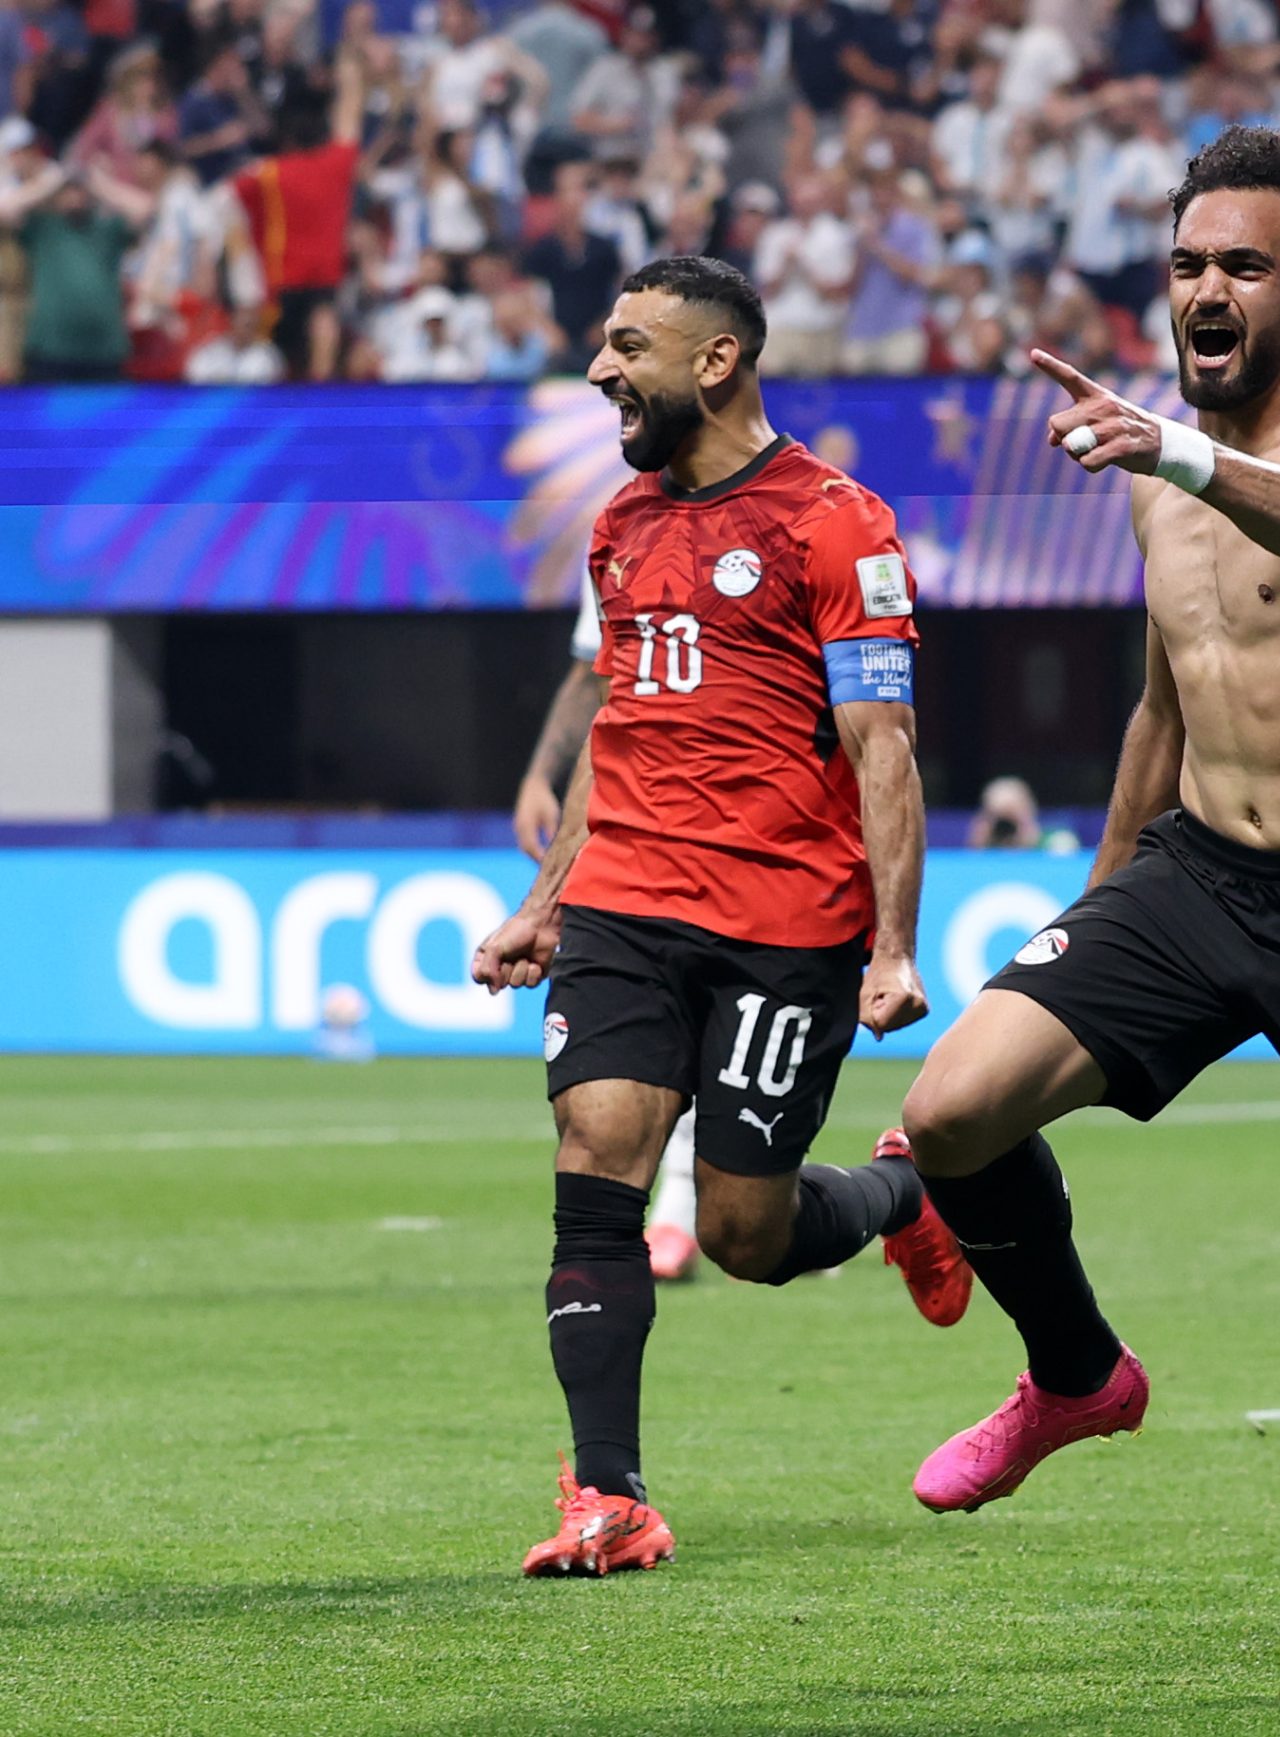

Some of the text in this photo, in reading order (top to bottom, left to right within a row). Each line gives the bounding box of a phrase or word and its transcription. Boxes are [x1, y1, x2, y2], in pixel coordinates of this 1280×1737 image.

[634, 613, 702, 695] 10
[862, 655, 911, 673] UNITES
[862, 671, 881, 685] the
[718, 992, 812, 1097] 10
